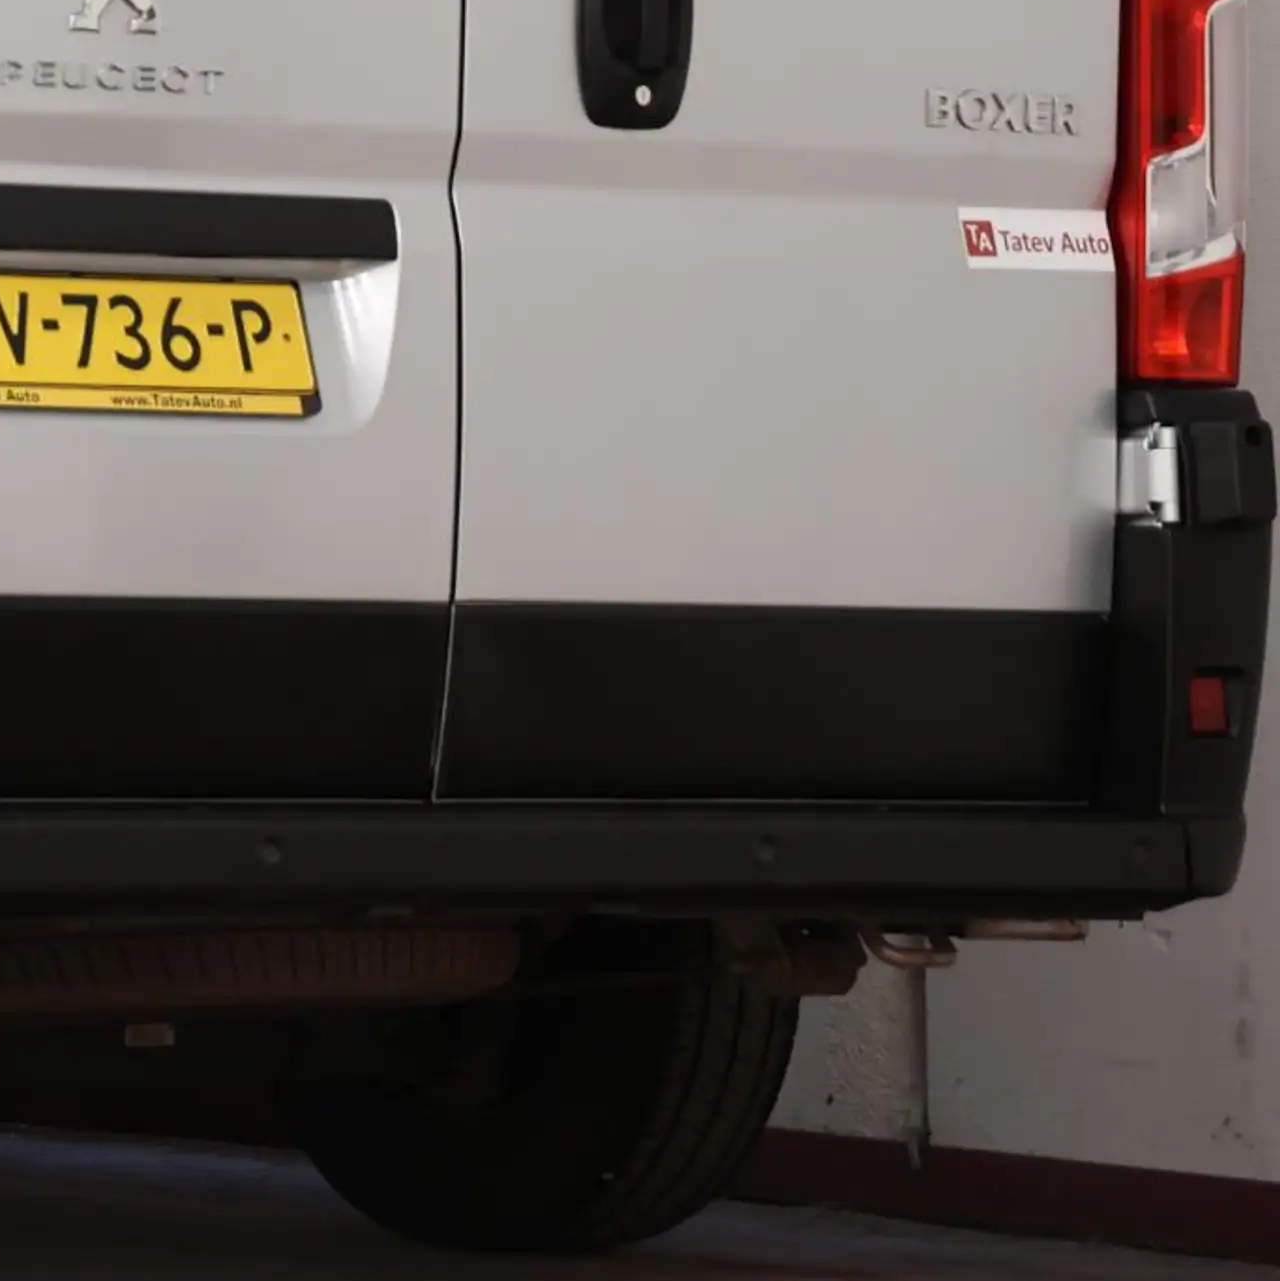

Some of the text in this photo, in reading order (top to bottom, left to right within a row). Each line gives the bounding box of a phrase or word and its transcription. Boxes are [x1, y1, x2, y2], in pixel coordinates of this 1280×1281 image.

[924, 88, 1078, 136] BOXER
[998, 230, 1055, 253] Tatev
[1061, 231, 1109, 254] Auto
[5, 388, 40, 402] Auto
[111, 393, 243, 409] www.TatevAuto.nl
